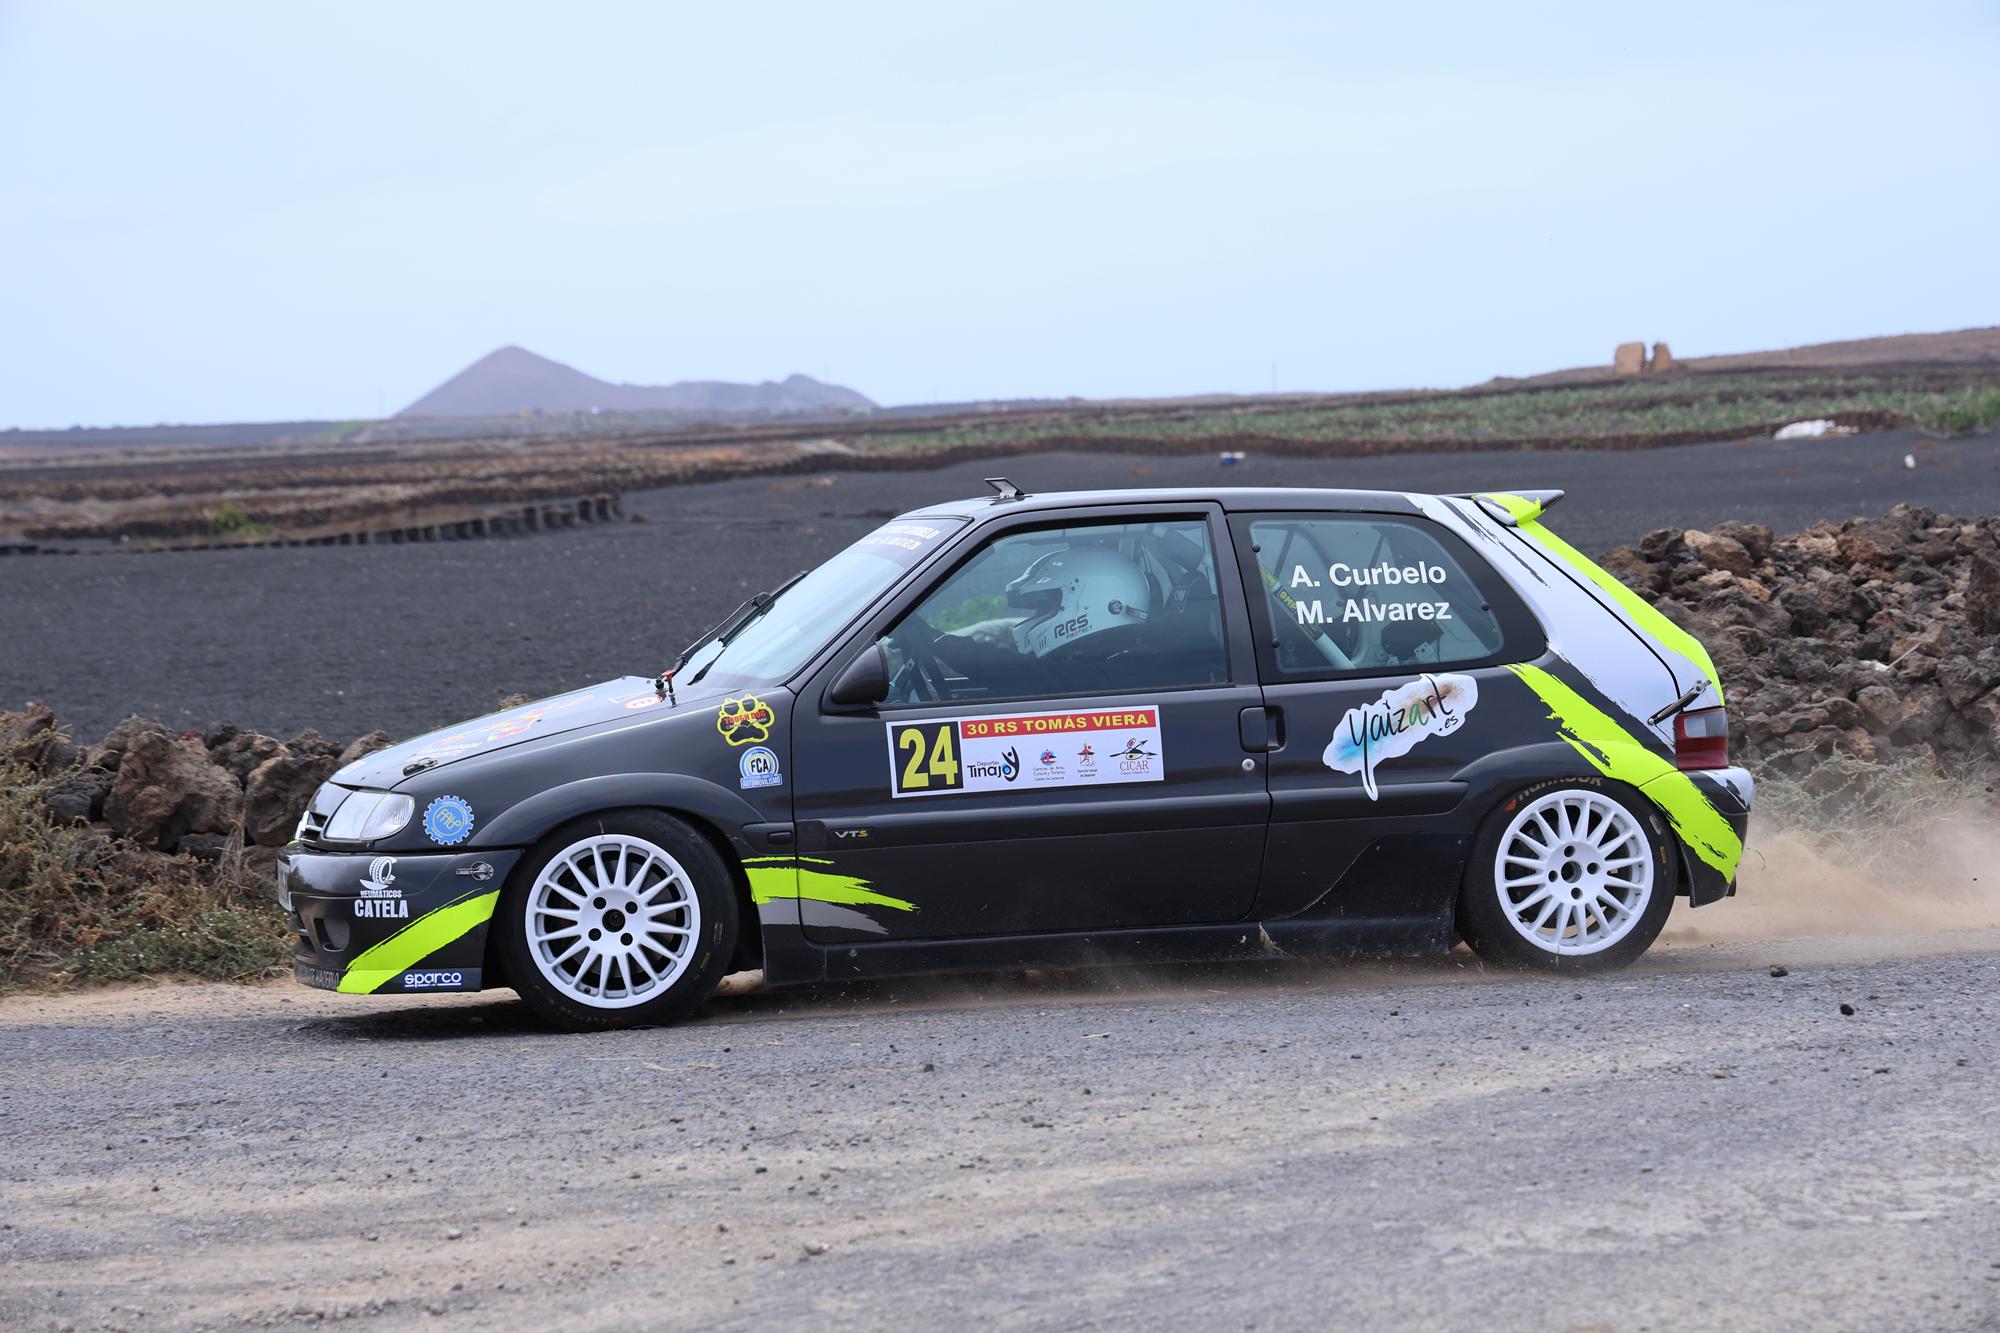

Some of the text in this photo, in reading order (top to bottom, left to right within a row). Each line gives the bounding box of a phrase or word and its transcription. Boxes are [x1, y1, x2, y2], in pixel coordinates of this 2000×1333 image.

[1291, 561, 1447, 588] A. Curbelo
[1295, 598, 1452, 625] M. Alvarez
[1054, 613, 1089, 639] RRS
[725, 713, 750, 725] TOUGH
[966, 714, 1149, 735] 30 RS TOMÁS VIERA
[750, 757, 769, 774] FCA
[899, 725, 959, 789] 24
[1119, 760, 1149, 771] CICAR
[834, 830, 868, 838] VTS
[354, 899, 409, 918] CATELA
[404, 972, 462, 988] sparco
